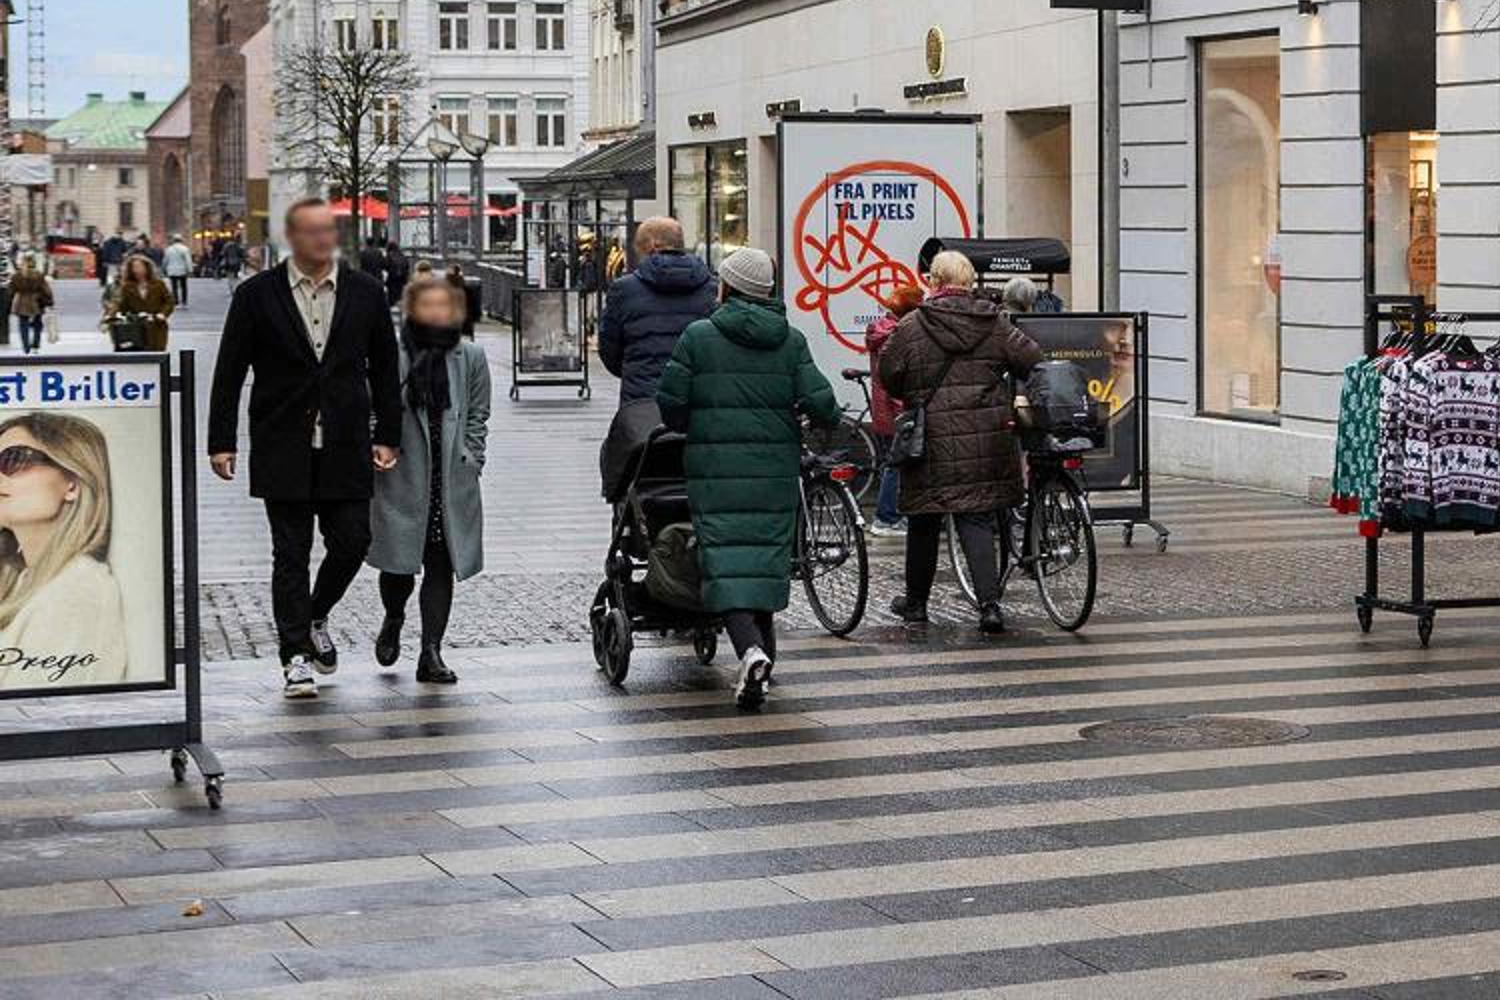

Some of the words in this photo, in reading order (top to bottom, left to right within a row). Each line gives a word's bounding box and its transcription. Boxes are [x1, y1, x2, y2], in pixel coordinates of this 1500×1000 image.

[835, 184, 864, 199] FRA
[872, 184, 918, 199] PRINT
[862, 203, 915, 220] PIXELS
[40, 371, 155, 401] Briller
